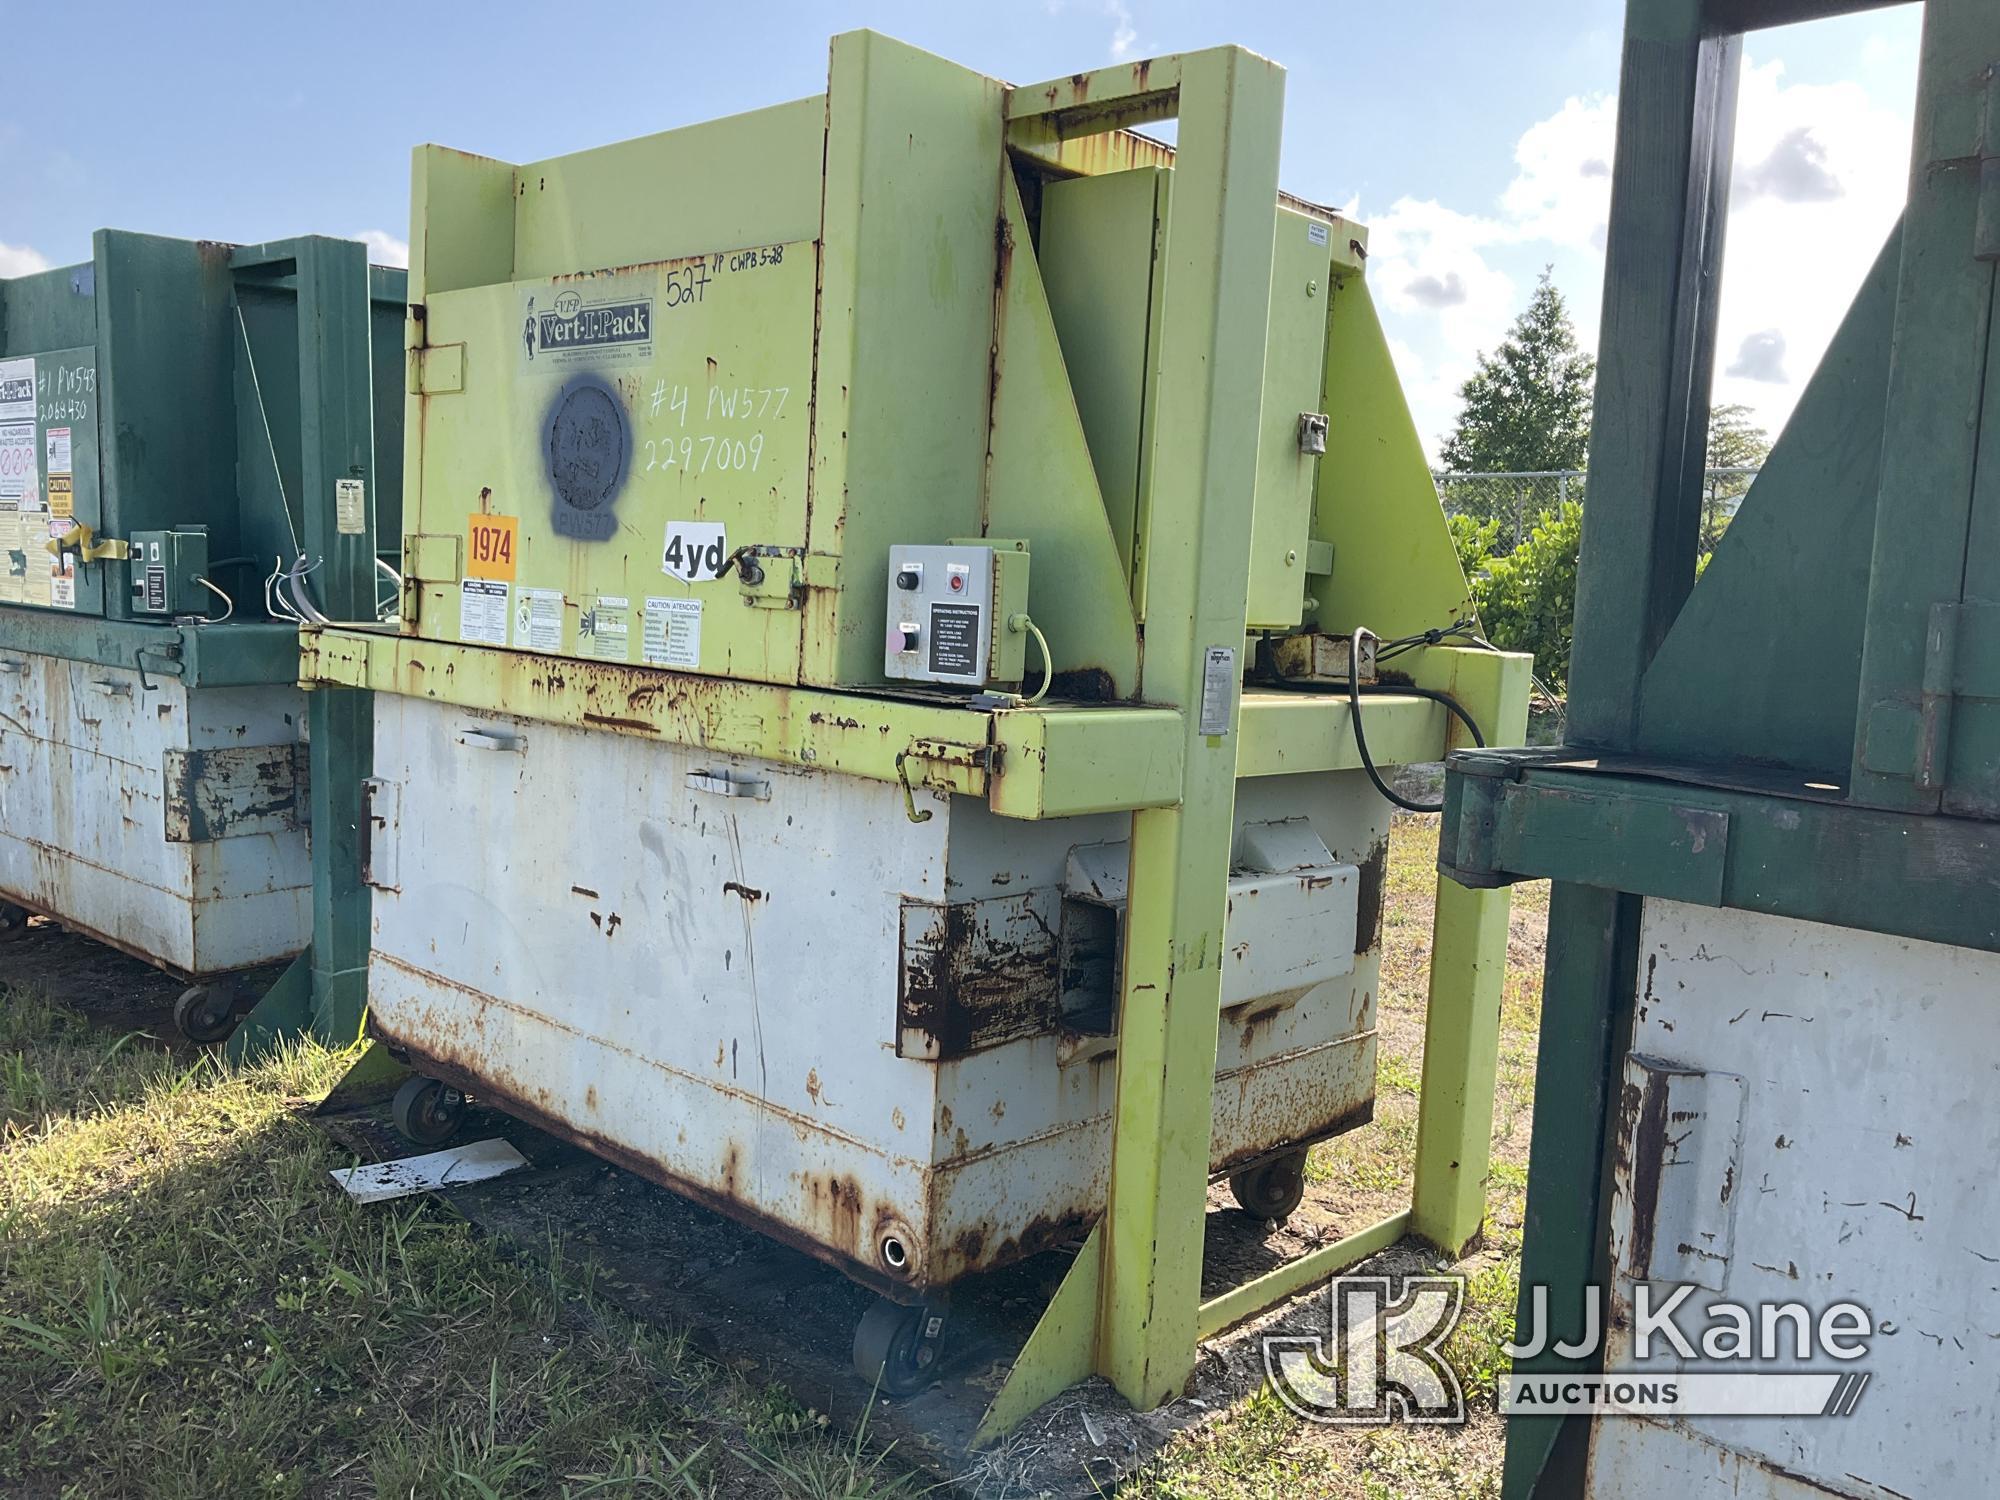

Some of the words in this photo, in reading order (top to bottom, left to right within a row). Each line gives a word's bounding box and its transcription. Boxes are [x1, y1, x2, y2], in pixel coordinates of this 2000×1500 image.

[730, 251, 757, 272] CWPB
[667, 263, 711, 307] 527
[58, 366, 95, 394] PW543
[40, 399, 87, 422] 2068430
[651, 379, 688, 427] #4
[706, 385, 789, 420] PW577
[645, 433, 764, 473] 2297009
[473, 526, 511, 564] 1974
[665, 534, 725, 579] 4yd
[648, 600, 671, 609] CAUTION
[672, 602, 699, 612] ATENCION
